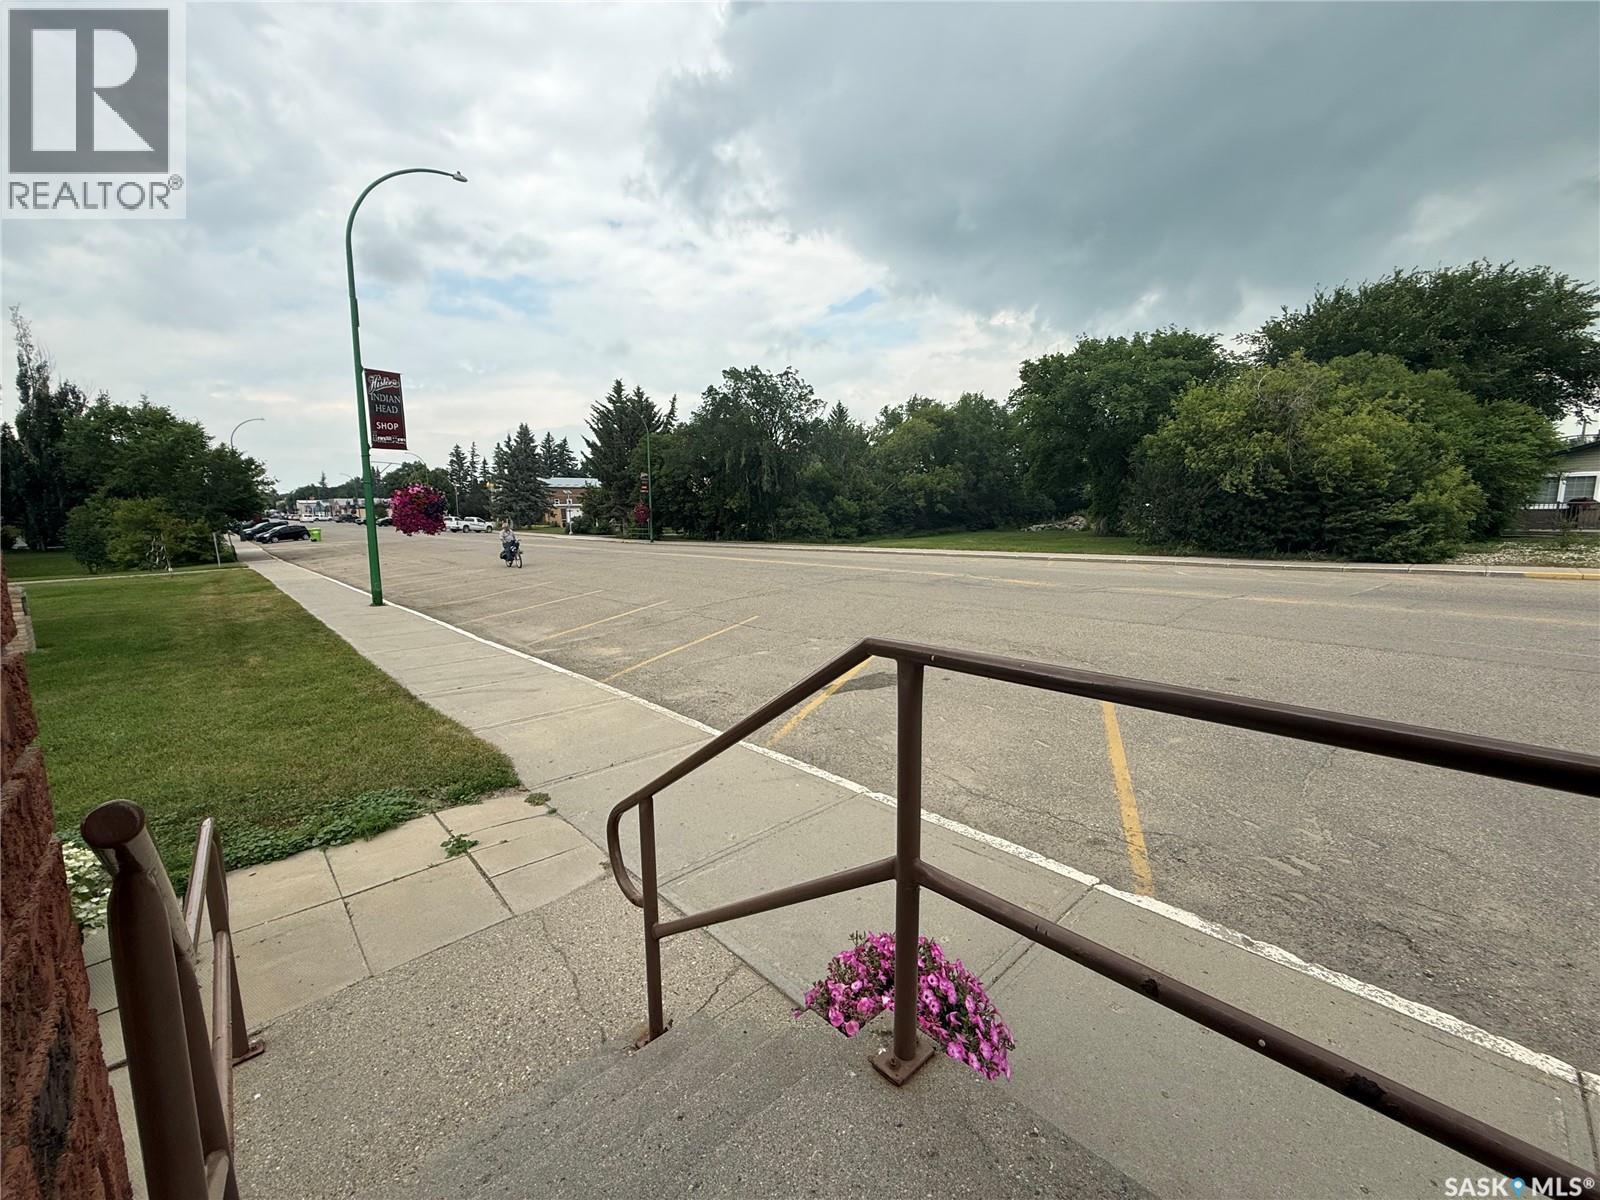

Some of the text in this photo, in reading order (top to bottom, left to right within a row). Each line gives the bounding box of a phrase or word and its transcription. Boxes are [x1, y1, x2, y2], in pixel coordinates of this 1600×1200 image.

[371, 393, 401, 403] INDIAN
[375, 404, 398, 414] HEAD
[376, 421, 399, 430] SHOP
